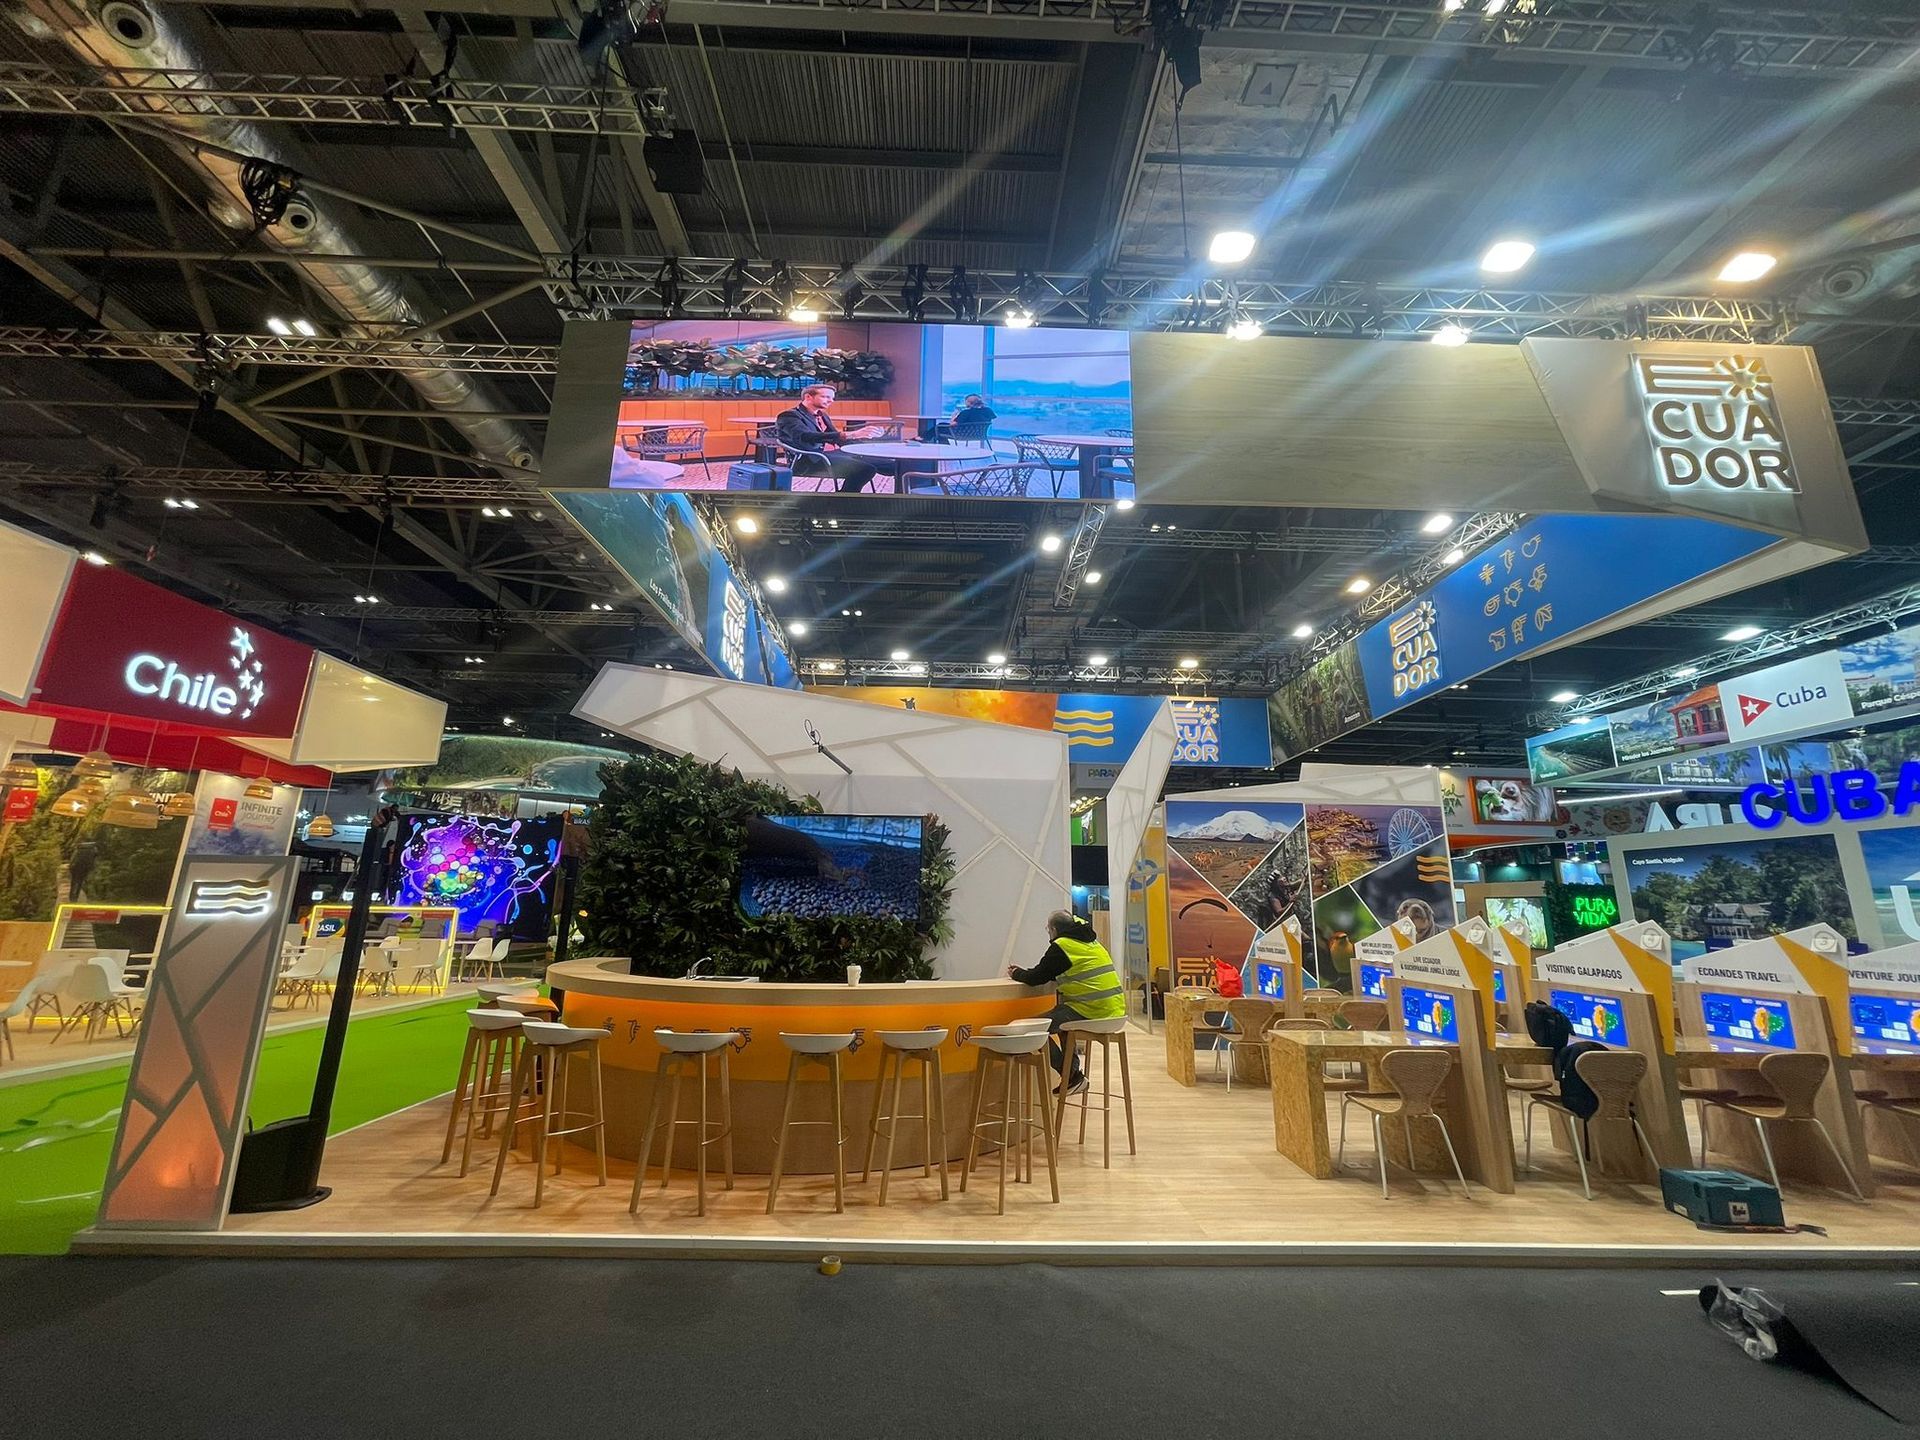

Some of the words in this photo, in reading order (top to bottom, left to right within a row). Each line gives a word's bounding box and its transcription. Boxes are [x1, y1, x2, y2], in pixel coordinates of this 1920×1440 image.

[1651, 400, 1783, 442] CUA
[1659, 446, 1794, 489] DOR
[1392, 631, 1438, 671] CUA
[125, 653, 238, 715] Chile
[1393, 656, 1440, 698] DOR
[1776, 686, 1828, 708] Cuba
[1861, 697, 1892, 710] Parque
[241, 801, 284, 816] INFINITE
[1575, 897, 1617, 915] PURA
[1573, 911, 1610, 926] VIDA
[317, 924, 336, 932] ASIL
[1545, 963, 1576, 976] VISITING
[1577, 966, 1623, 980] GALAPAGOS
[1698, 967, 1743, 980] ECOANDES
[1744, 970, 1782, 983] TRAVEL
[1848, 969, 1894, 982] VENTURE
[1897, 973, 1920, 984] JOU
